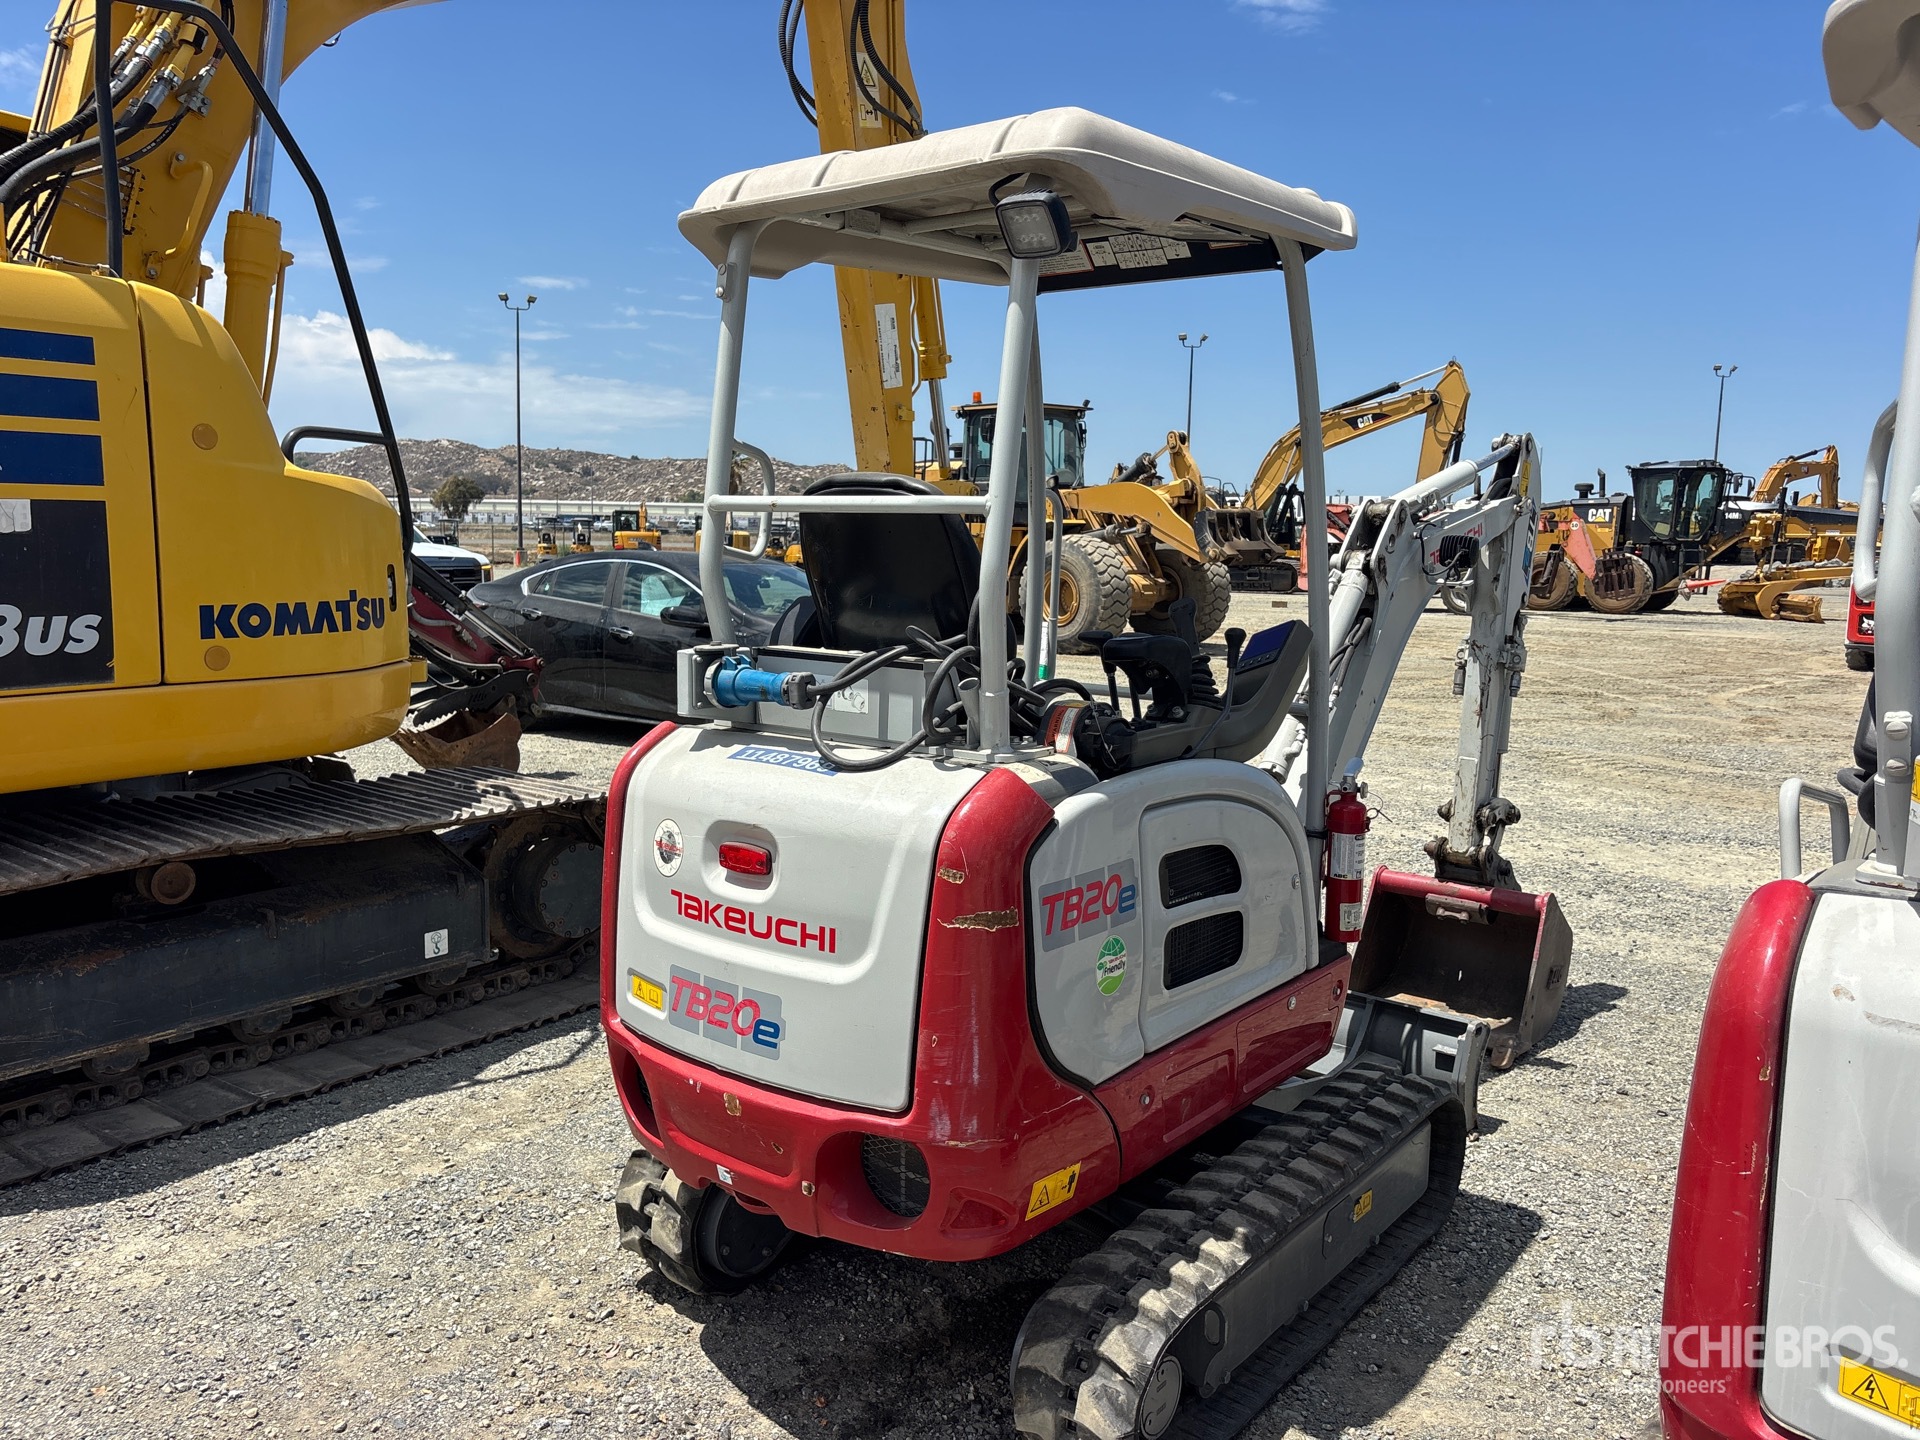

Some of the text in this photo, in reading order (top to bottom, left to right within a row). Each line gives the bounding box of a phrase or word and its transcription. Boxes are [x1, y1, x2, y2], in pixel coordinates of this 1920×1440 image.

[1357, 414, 1374, 429] CAT
[1588, 508, 1612, 522] CAT
[199, 589, 385, 640] KOMATSU
[1041, 873, 1136, 936] TB20e
[671, 975, 781, 1050] TB20e
